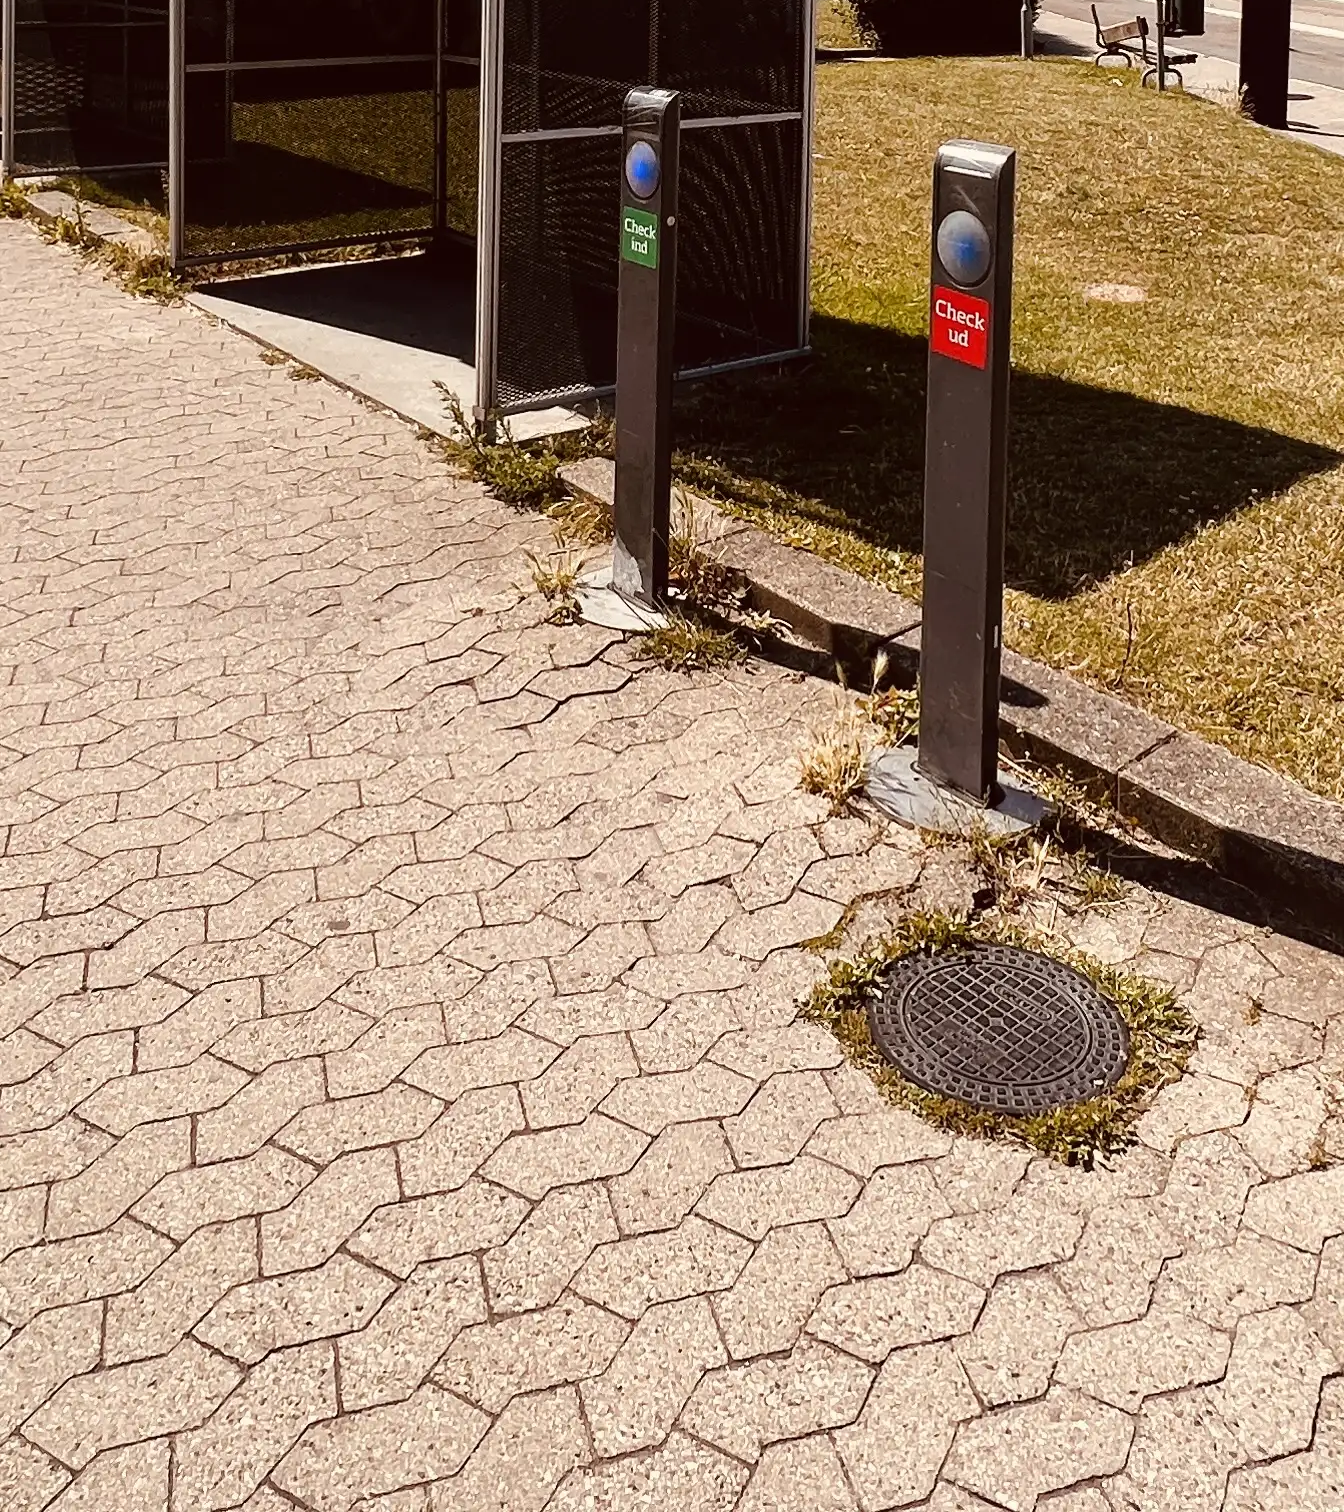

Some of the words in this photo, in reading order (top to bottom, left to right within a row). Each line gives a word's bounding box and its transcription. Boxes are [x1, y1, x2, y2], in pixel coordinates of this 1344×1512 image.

[624, 217, 657, 240] Check
[631, 236, 648, 255] ind
[935, 299, 986, 332] Check
[948, 328, 969, 348] ud
